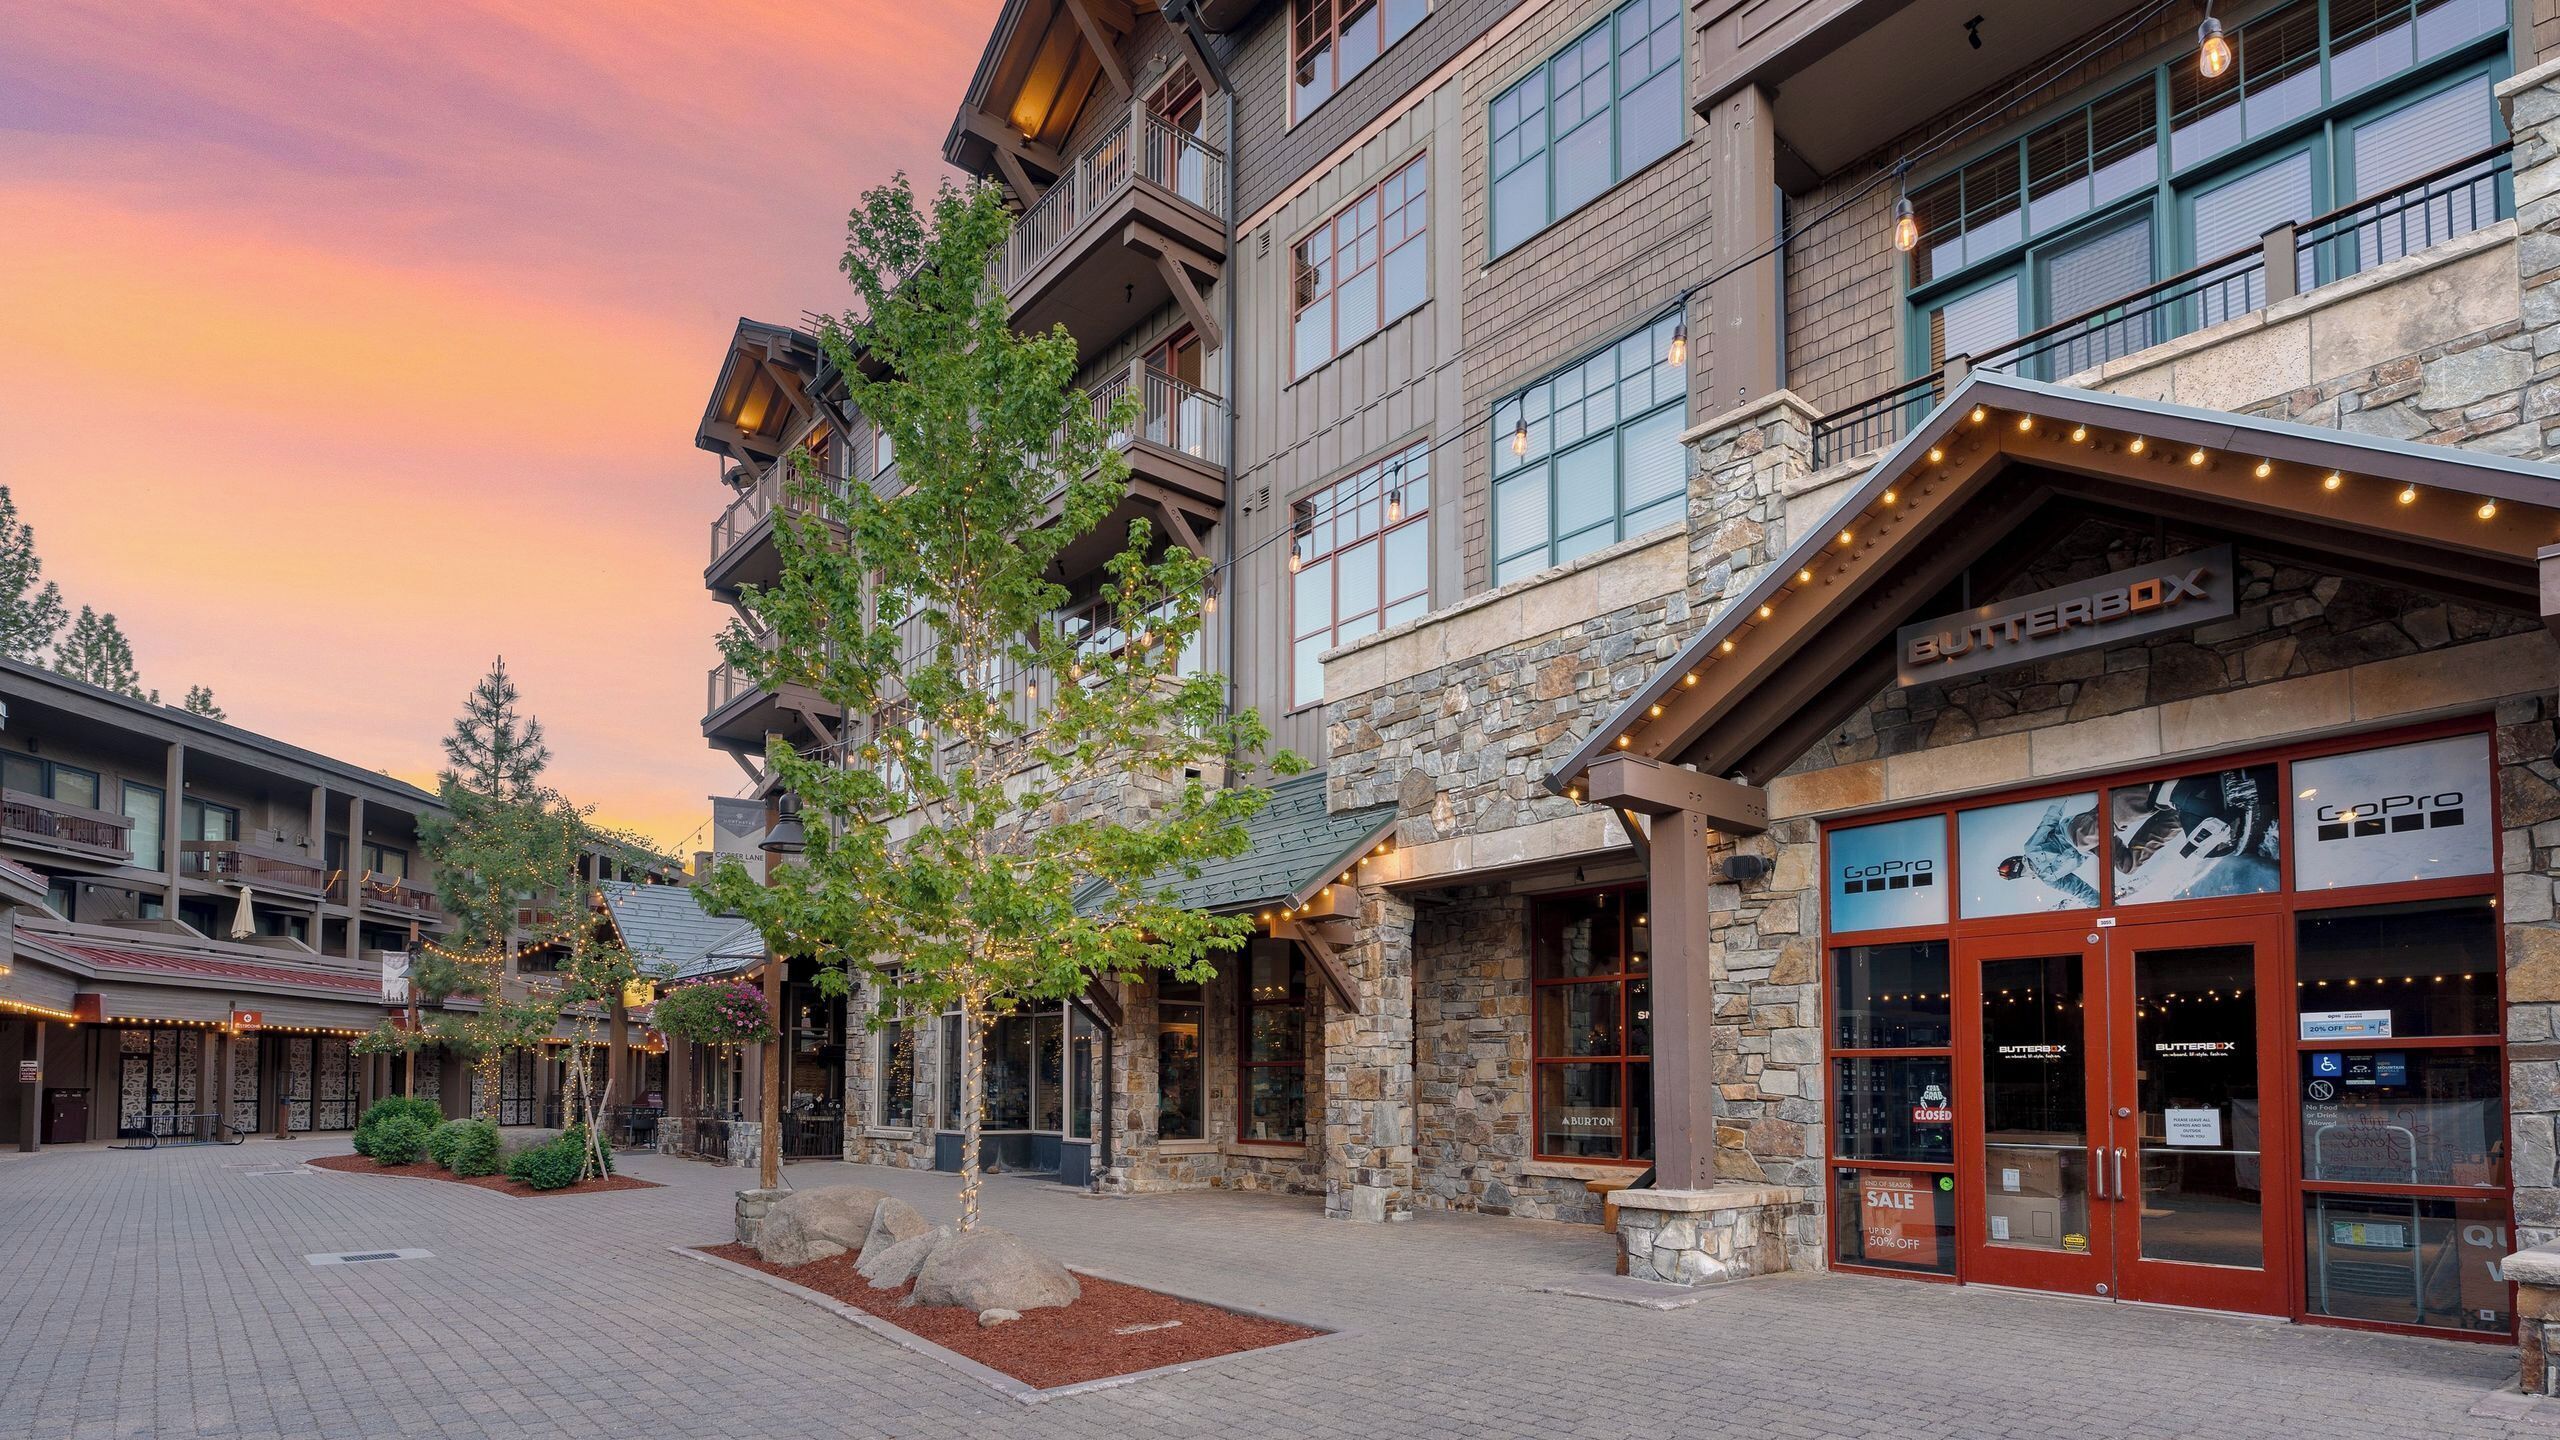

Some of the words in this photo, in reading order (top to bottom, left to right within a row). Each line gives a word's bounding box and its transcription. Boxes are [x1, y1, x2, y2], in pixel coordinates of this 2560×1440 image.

[1907, 567, 2210, 665] BUTTERBOX
[2317, 792, 2464, 822] GoPro
[1844, 859, 1933, 879] GoPro
[1999, 1044, 2067, 1053] BUTTERBOX
[2155, 1042, 2235, 1051] BUTTERBOX
[1923, 1091, 1943, 1101] GRAB
[1914, 1110, 1952, 1121] CLOSED
[1570, 1116, 1615, 1127] BURTON
[1867, 1190, 1914, 1209] SALE
[1881, 1227, 1892, 1236] TO
[1869, 1236, 1895, 1248] 50%
[1897, 1238, 1920, 1250] OFF
